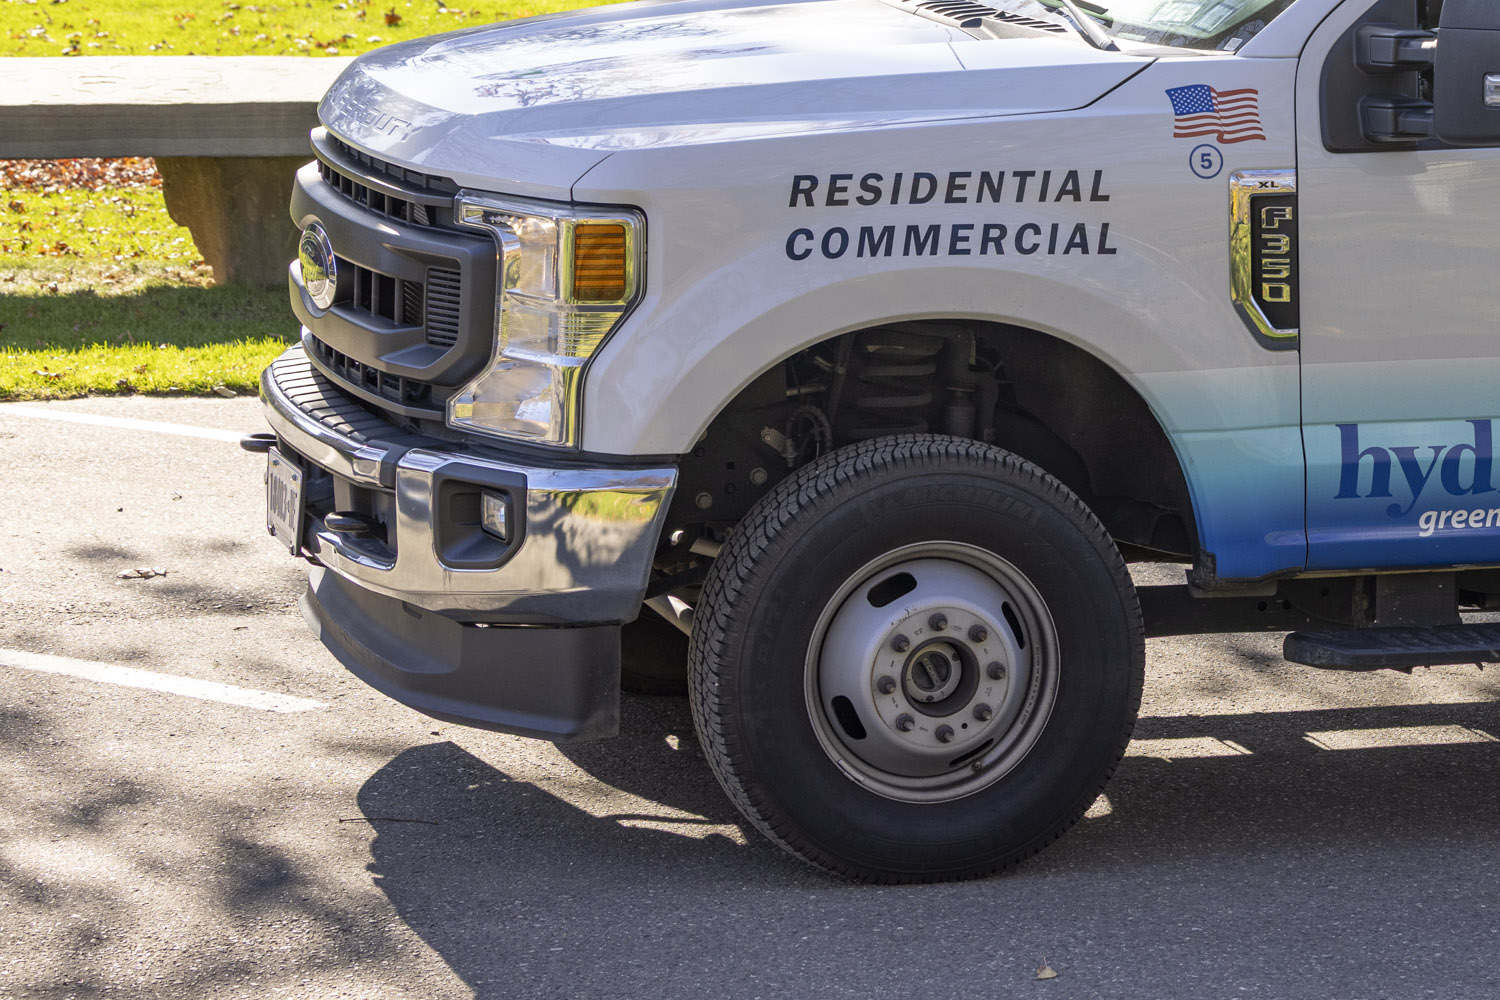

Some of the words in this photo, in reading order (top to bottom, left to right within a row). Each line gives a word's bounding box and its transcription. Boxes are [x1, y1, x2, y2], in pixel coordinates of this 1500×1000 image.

[1200, 152, 1213, 170] 5
[788, 170, 1111, 208] RESIDENTIAL
[1258, 181, 1280, 189] XL
[785, 222, 1118, 261] COMMERCIAL
[1261, 206, 1292, 303] F350
